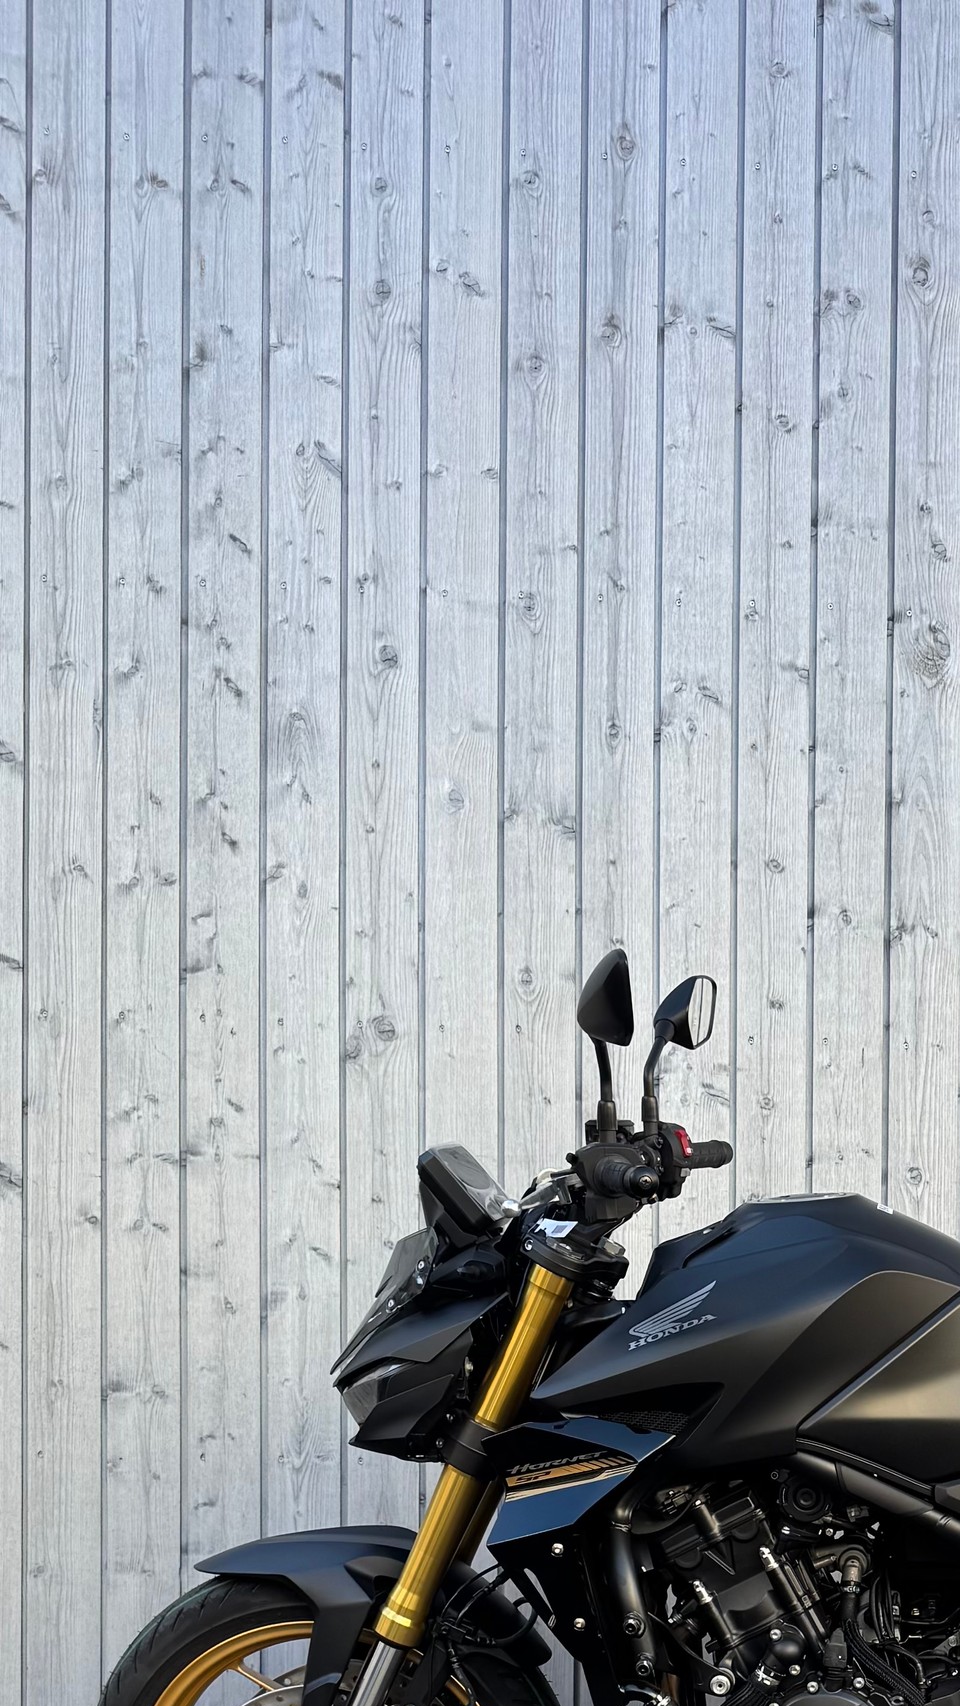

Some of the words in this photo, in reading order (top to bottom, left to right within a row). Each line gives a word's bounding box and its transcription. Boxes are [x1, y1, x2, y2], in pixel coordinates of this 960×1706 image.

[628, 1314, 717, 1351] HONDA
[506, 1450, 608, 1475] HORNET
[515, 1470, 552, 1484] SP
